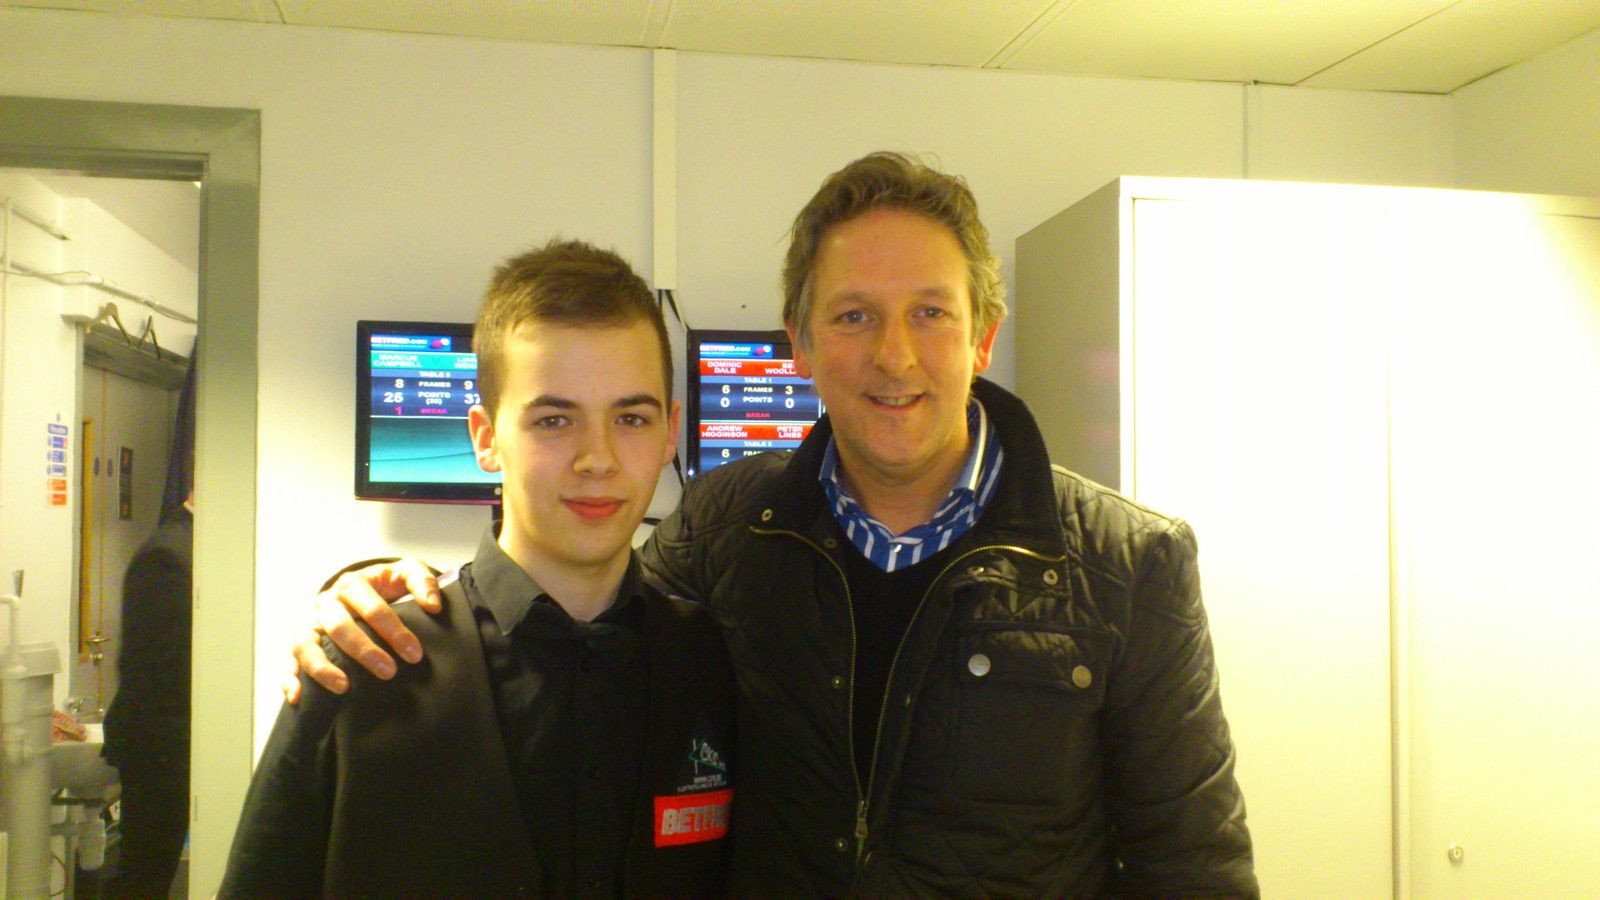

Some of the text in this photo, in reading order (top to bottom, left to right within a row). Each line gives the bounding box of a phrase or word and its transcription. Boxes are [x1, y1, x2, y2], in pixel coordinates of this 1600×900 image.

[373, 360, 422, 368] CAMPBELL
[394, 378, 404, 389] 8
[464, 380, 474, 390] 9
[722, 385, 730, 394] 6
[785, 385, 793, 395] 3
[383, 391, 404, 403] 25
[720, 397, 730, 408] 0
[785, 398, 794, 409] 0
[395, 406, 402, 416] 1
[721, 449, 730, 458] 6
